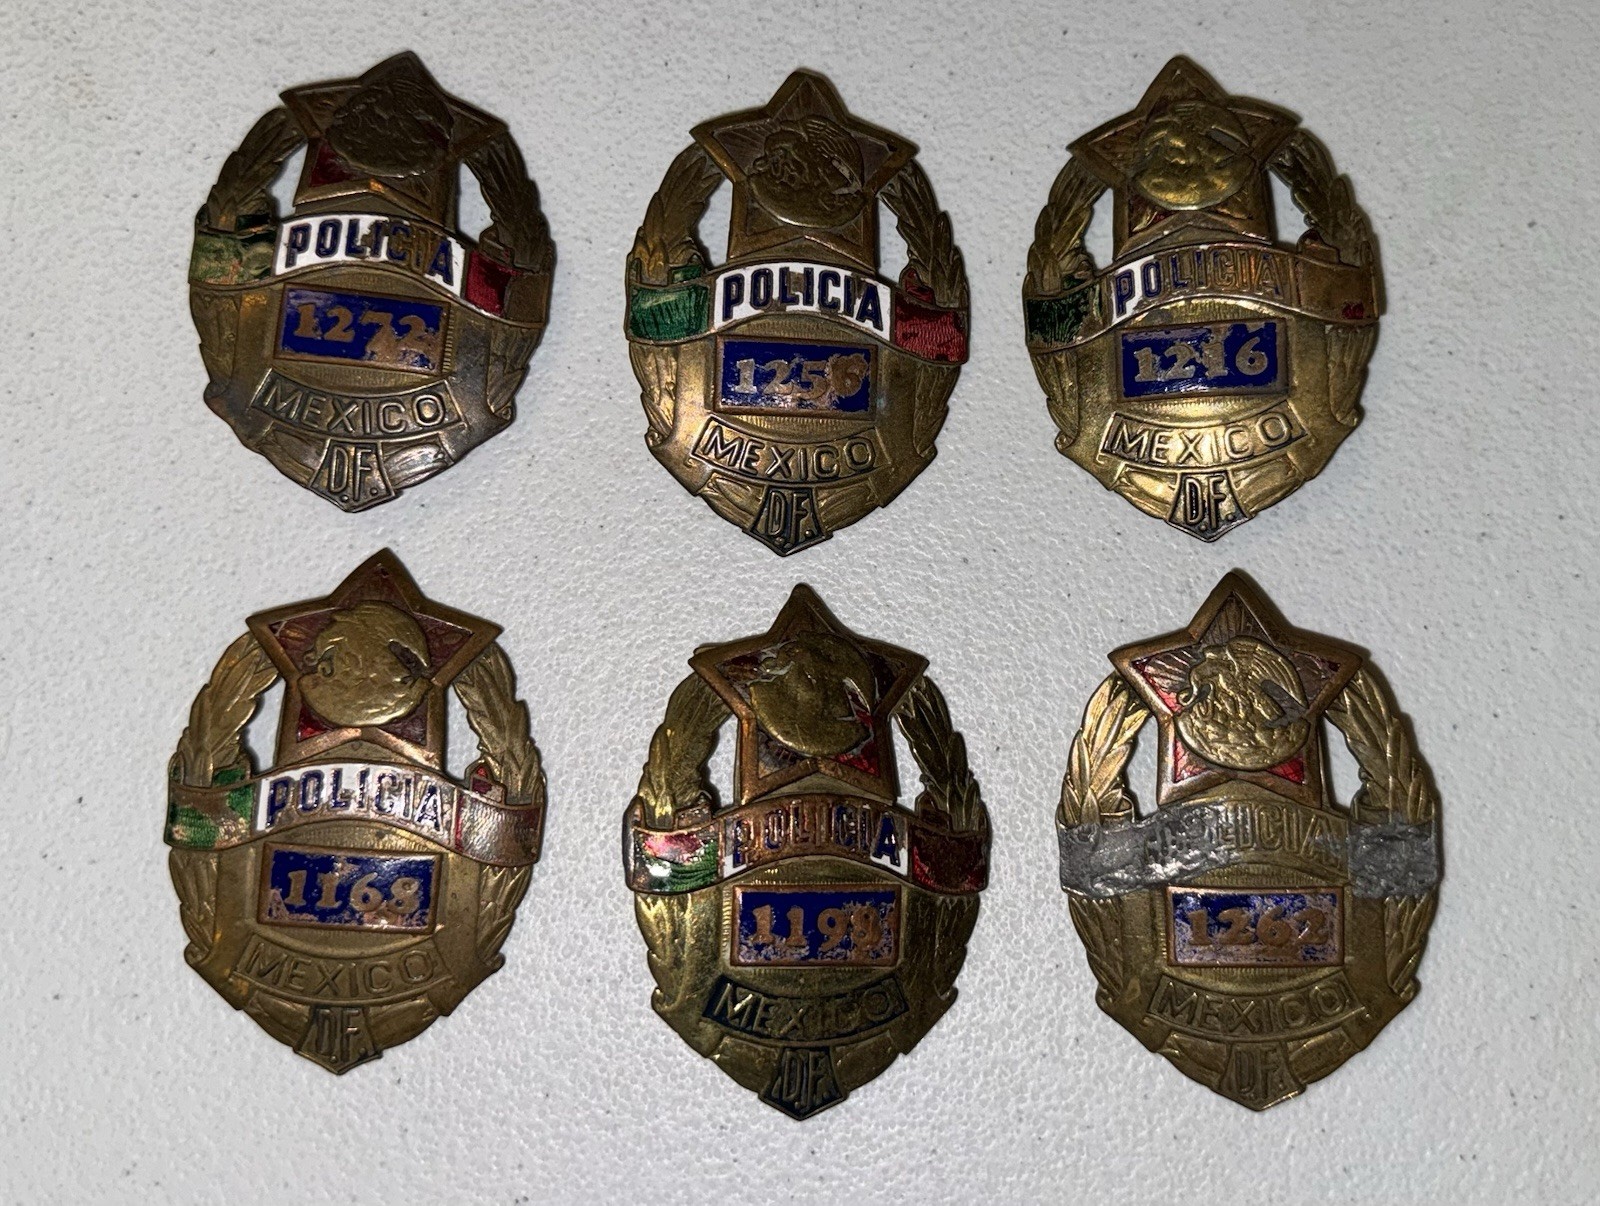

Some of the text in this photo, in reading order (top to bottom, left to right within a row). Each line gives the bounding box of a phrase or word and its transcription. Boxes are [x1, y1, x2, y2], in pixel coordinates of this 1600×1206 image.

[284, 217, 454, 287] POLICIA
[722, 266, 883, 331] POLICIA
[1112, 250, 1281, 317] POLICIA
[293, 303, 427, 347] 1272
[1132, 337, 1269, 382] 1216
[264, 384, 444, 434] MEXICO
[704, 426, 876, 480] MEXICO
[1113, 416, 1291, 464] MEXICO
[265, 766, 444, 834] POLICIA
[732, 801, 902, 868] POLICIA
[285, 869, 421, 916] 1168
[751, 903, 883, 951] 1198
[1188, 905, 1327, 948] 1262
[247, 943, 437, 995] MEXICO
[713, 982, 893, 1032] MEXICO
[1161, 980, 1349, 1033] MEXICO
